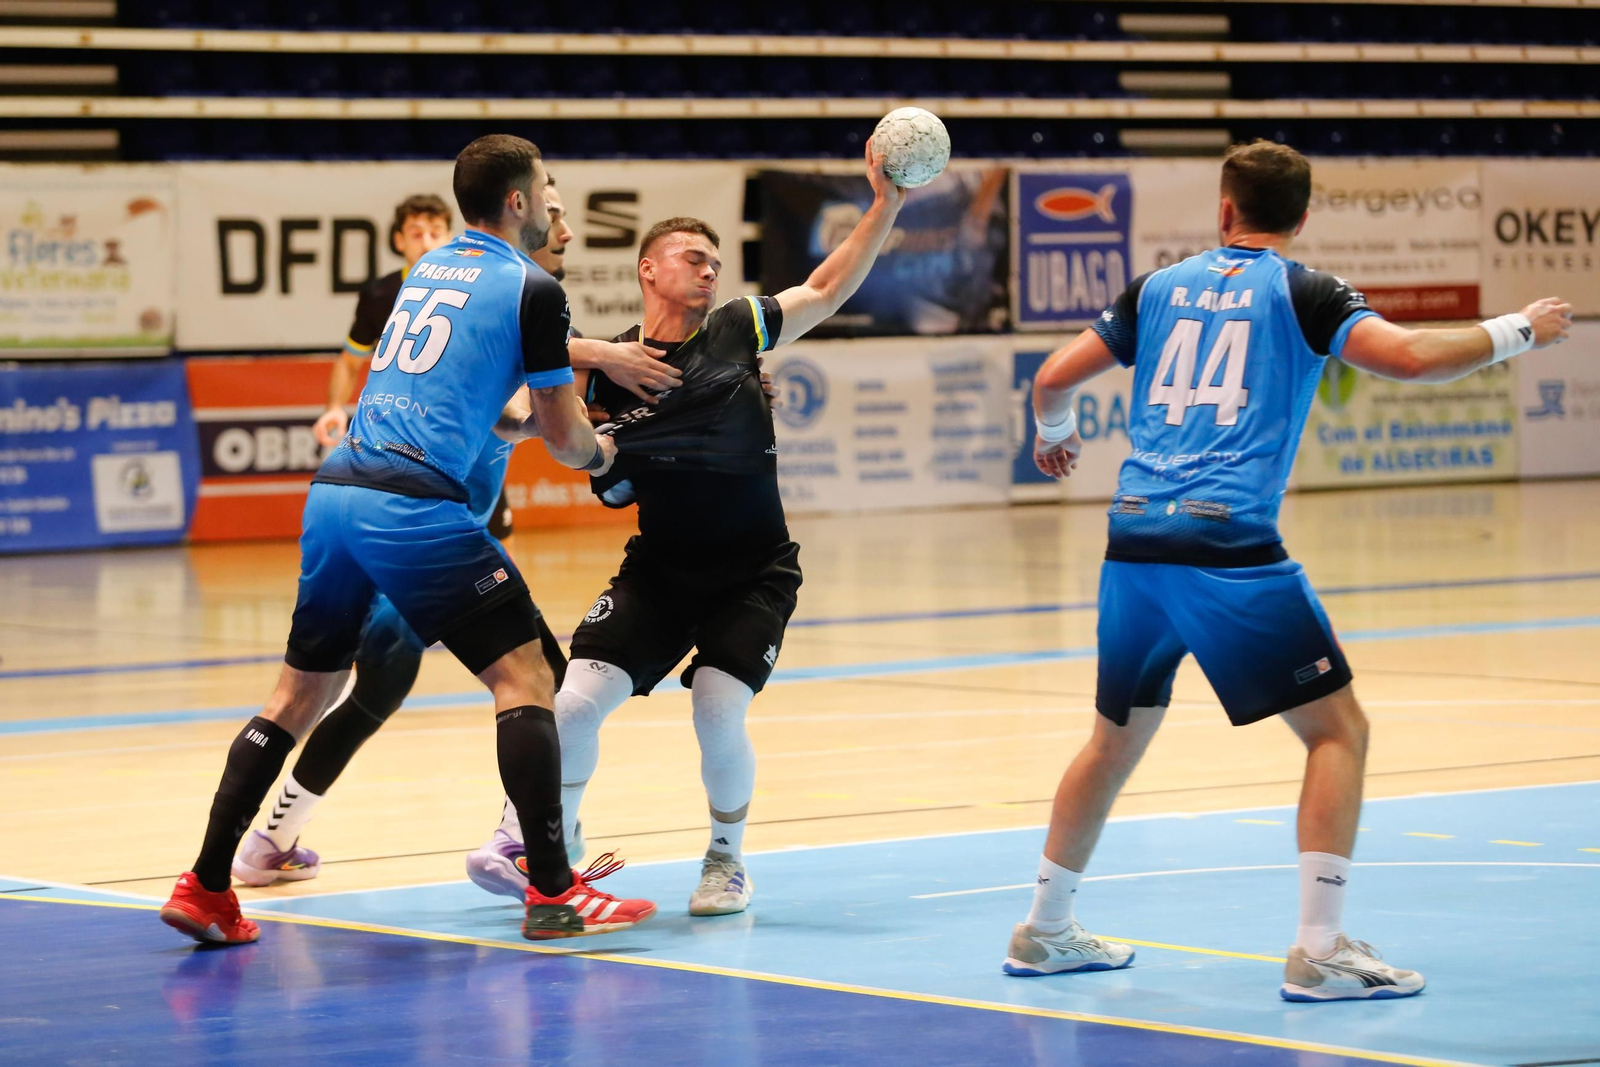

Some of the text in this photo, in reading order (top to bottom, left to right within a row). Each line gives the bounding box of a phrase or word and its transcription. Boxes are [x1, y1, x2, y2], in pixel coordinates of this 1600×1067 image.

[1495, 211, 1600, 244] OKEY
[217, 218, 403, 295] DFD
[413, 262, 483, 283] PAGANO
[566, 265, 638, 284] SEA
[1495, 254, 1591, 269] FITNES
[1028, 251, 1126, 312] UBAGO
[1170, 286, 1253, 312] R. ÁVILA
[370, 286, 471, 374] 55
[1148, 319, 1252, 425] 44
[1079, 394, 1130, 439] BA
